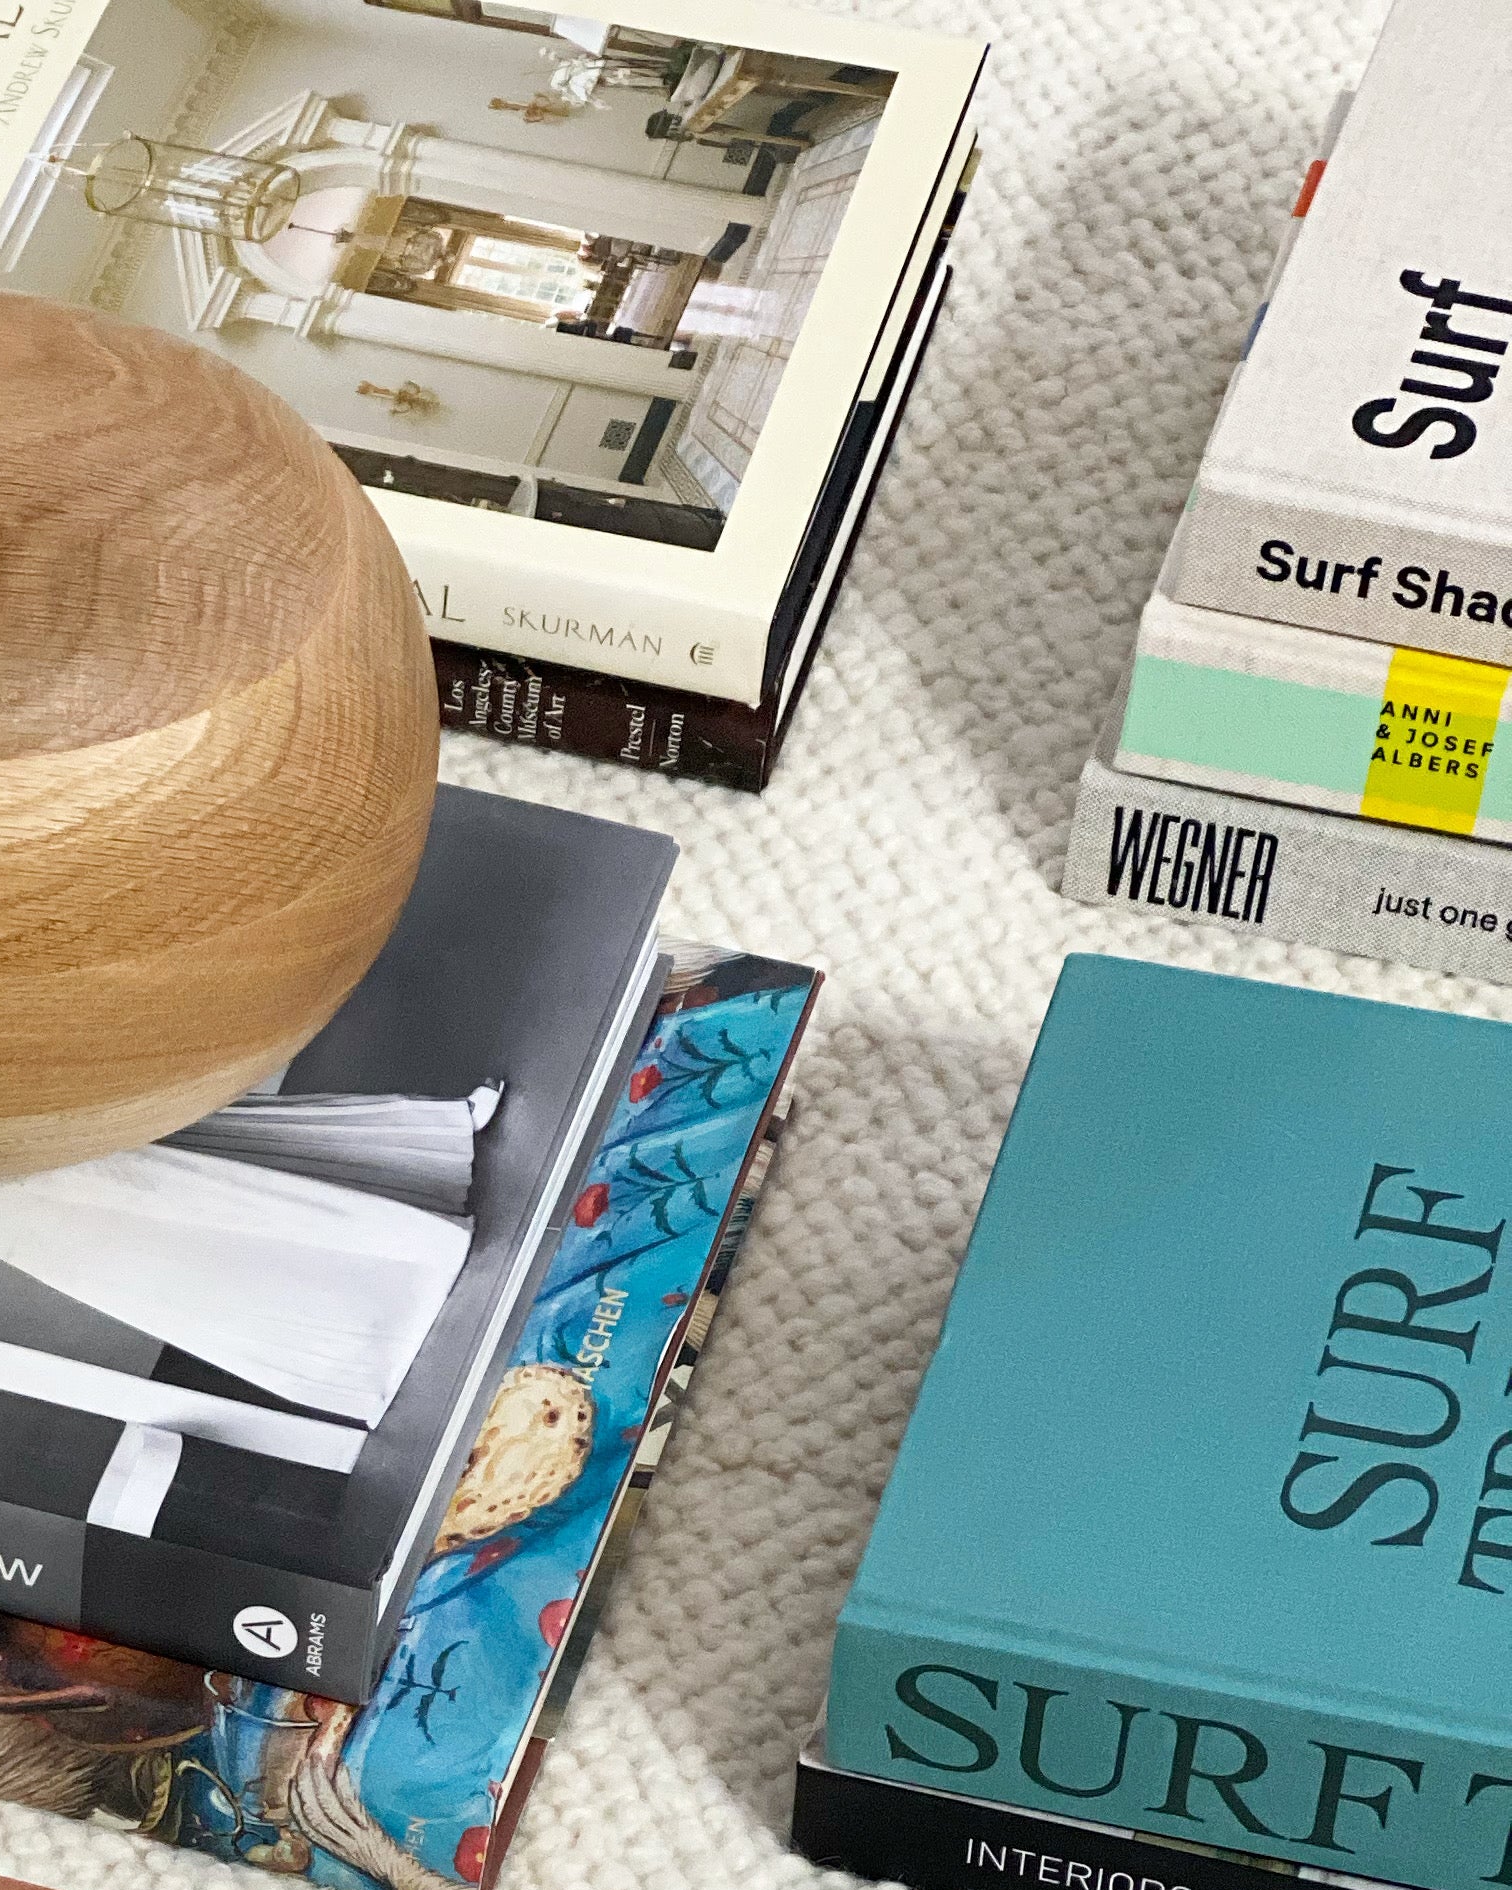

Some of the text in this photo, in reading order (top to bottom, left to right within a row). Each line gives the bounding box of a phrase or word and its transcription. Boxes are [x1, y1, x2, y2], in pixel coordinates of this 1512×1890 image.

[31, 0, 79, 38] SKU
[1352, 269, 1512, 459] Surf
[1256, 540, 1383, 599] Surf
[503, 605, 663, 656] SKURMAN
[444, 679, 465, 712] Los
[1380, 700, 1452, 727] ANNI
[620, 703, 646, 760] Prestel
[659, 713, 685, 767] Norton
[1376, 723, 1494, 757] & JOSEF
[1371, 746, 1480, 779] ALBERS
[1107, 806, 1279, 923] WEGNER
[1372, 888, 1433, 919] just
[1439, 905, 1499, 932] one
[573, 1287, 629, 1391] TASCHEN
[1280, 1162, 1505, 1546] SURF
[241, 1620, 283, 1651] A
[305, 1612, 327, 1678] ABRAMS
[885, 1663, 1424, 1854] SURF
